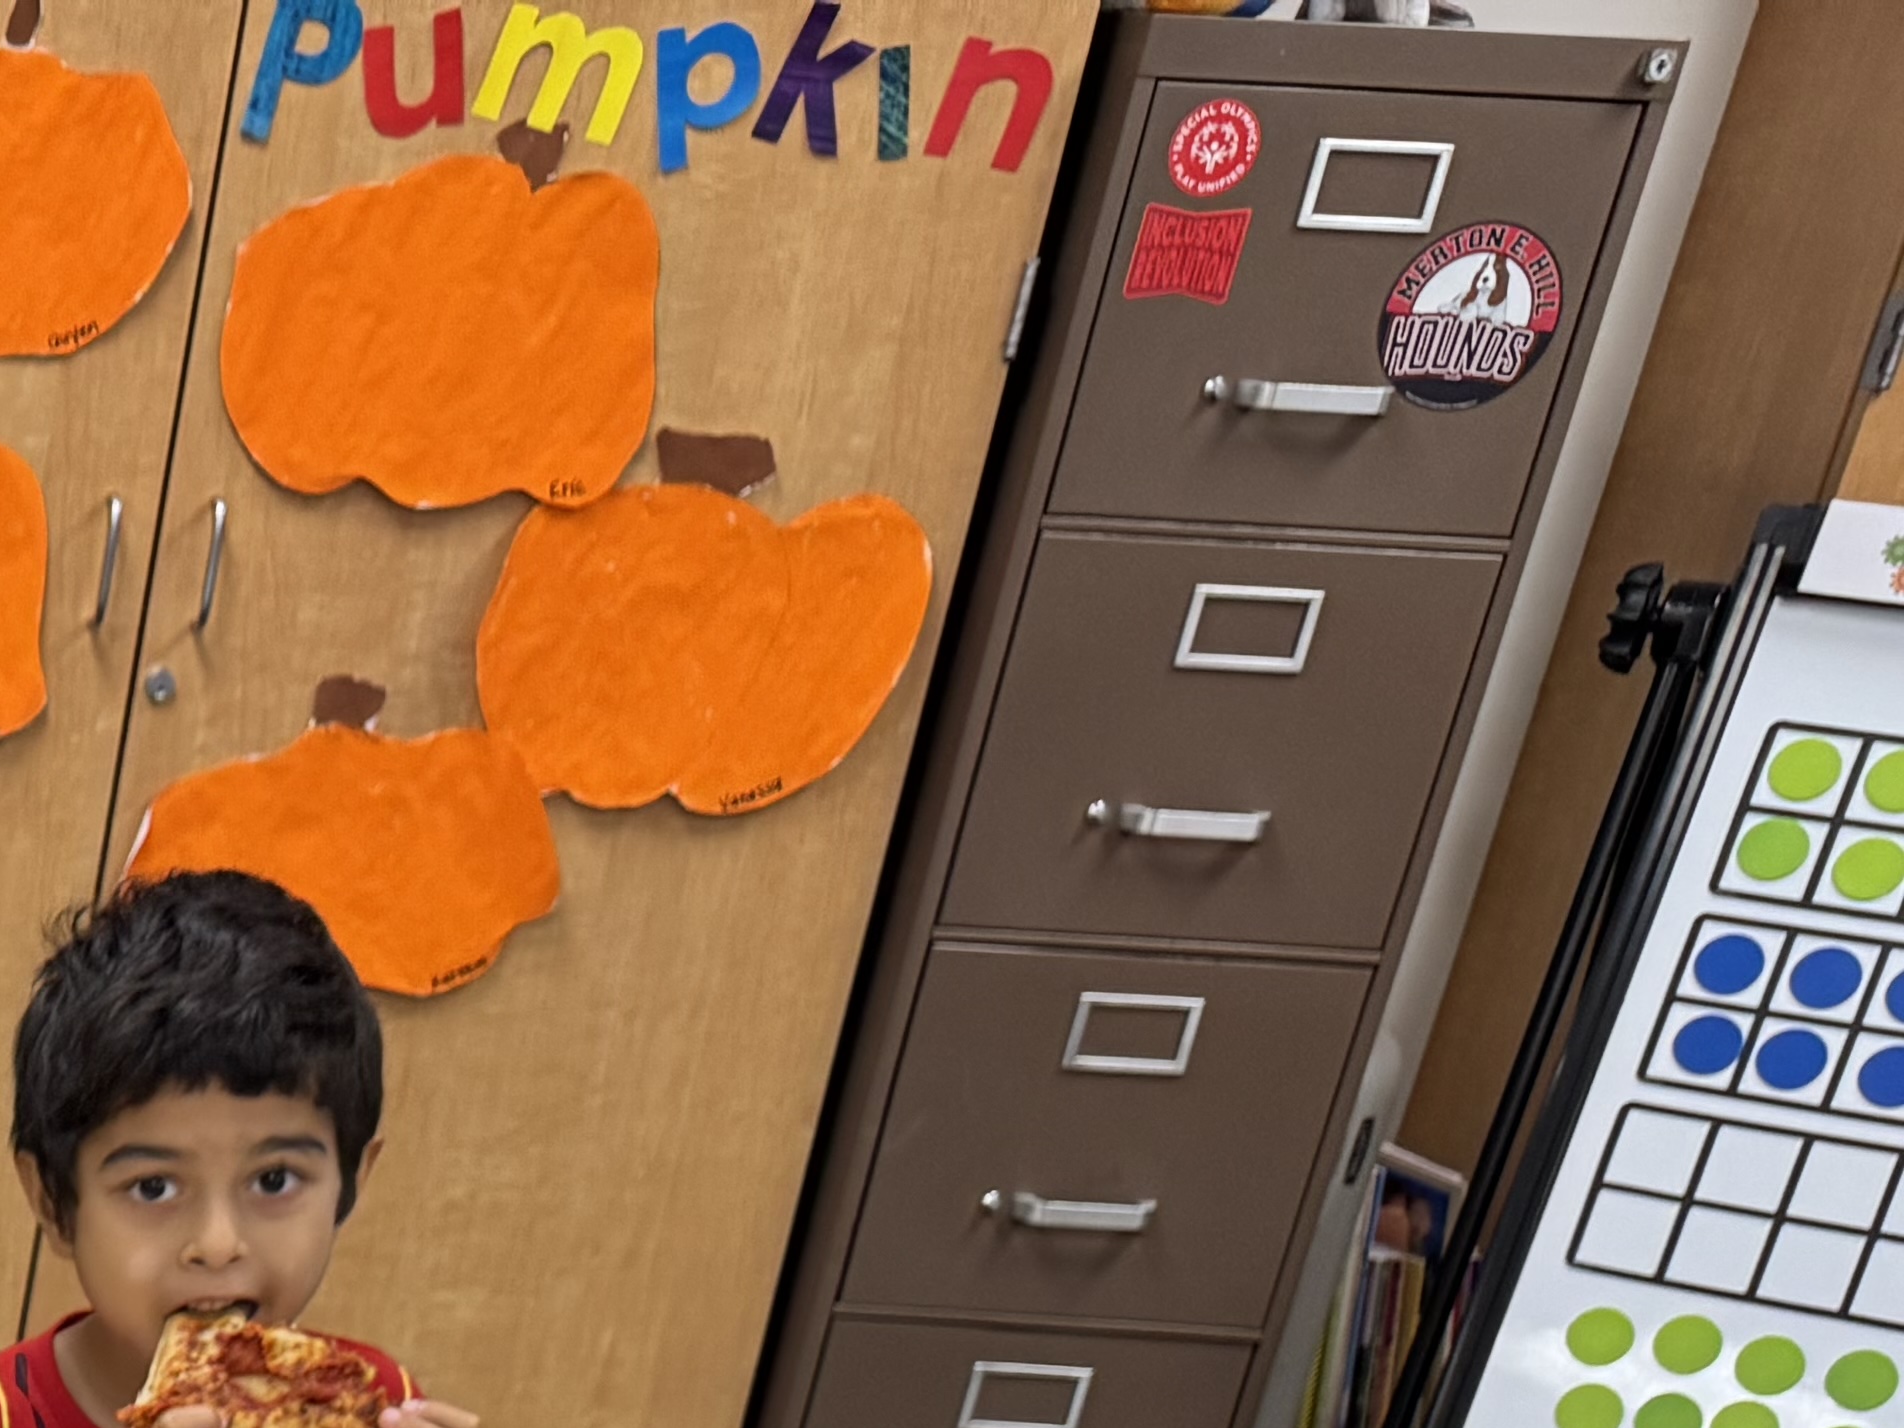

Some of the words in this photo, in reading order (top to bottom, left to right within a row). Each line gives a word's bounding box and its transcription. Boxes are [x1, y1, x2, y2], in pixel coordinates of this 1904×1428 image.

[1173, 105, 1217, 152] SPECIAL
[1174, 163, 1195, 189] PLAY
[1198, 163, 1245, 193] UNIFIED
[1397, 227, 1506, 299] MERTON
[1529, 254, 1555, 316] HILL
[1384, 316, 1534, 382] HOUNDS
